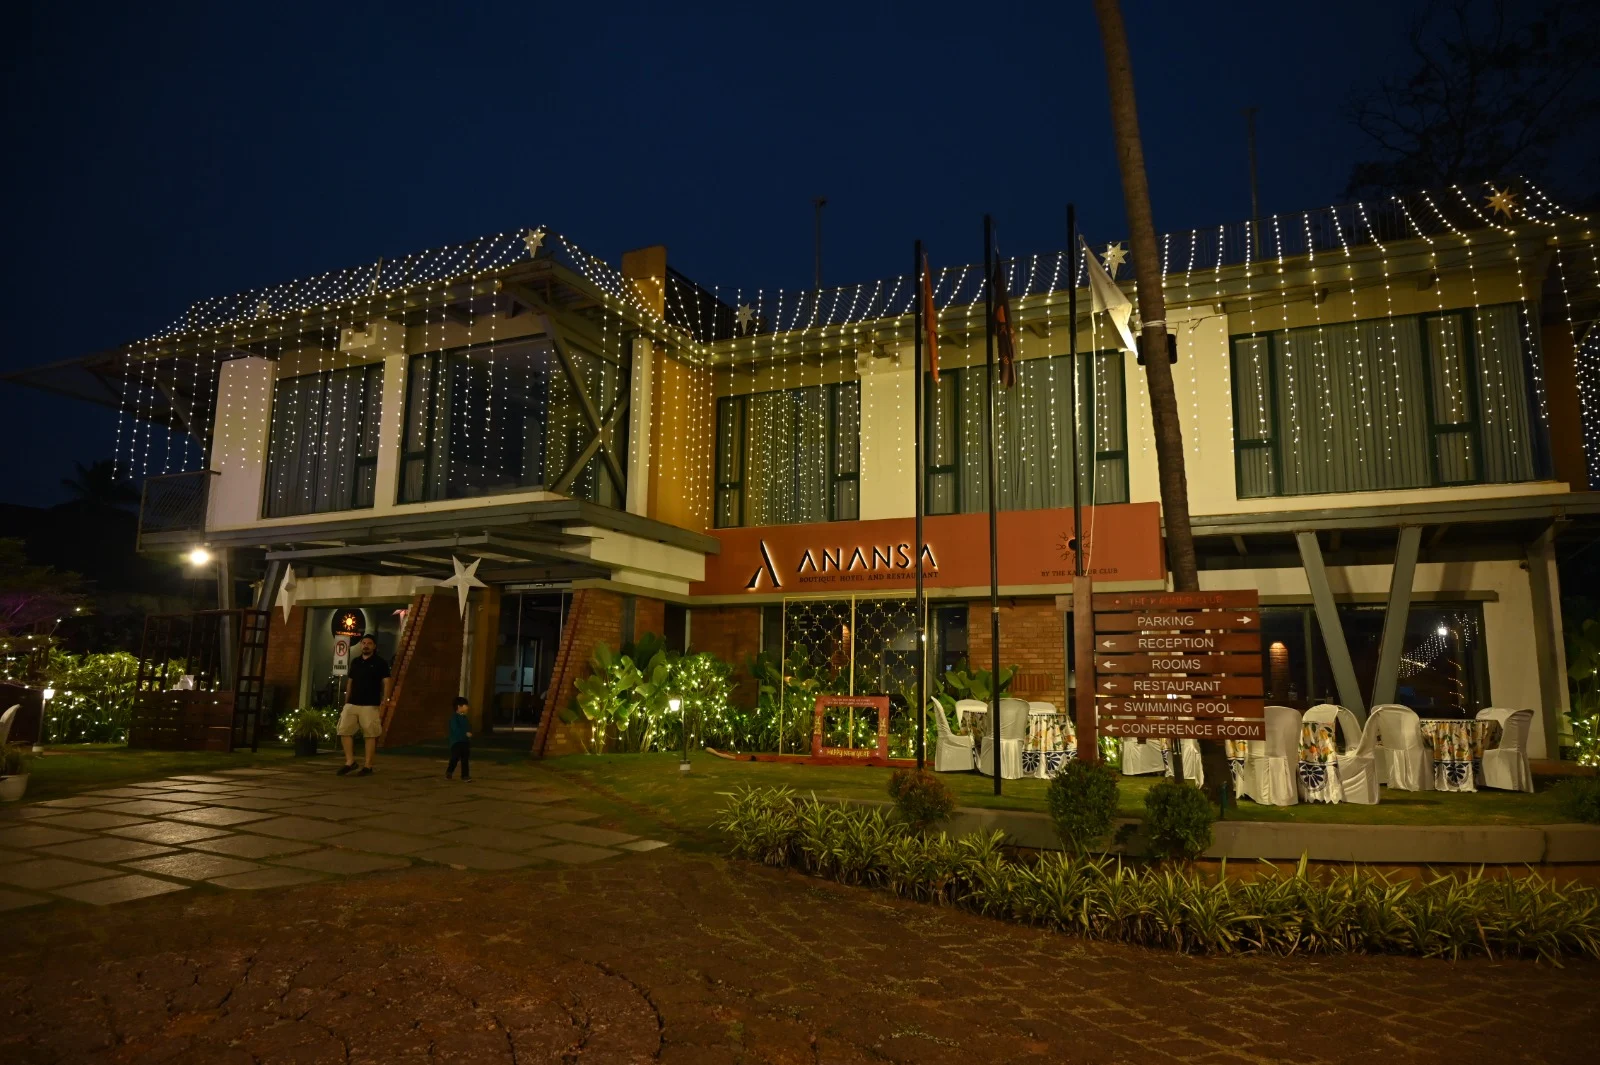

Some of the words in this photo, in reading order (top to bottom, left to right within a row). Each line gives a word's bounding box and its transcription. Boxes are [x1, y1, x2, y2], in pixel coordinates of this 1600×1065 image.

[796, 544, 938, 572] ANANSA
[799, 575, 836, 584] BOUTIQUE
[839, 574, 865, 582] HOTEL
[867, 573, 885, 581] AND
[886, 571, 939, 580] RESTAUANT
[1130, 597, 1146, 605] THE
[1197, 595, 1224, 604] CLUB
[1137, 615, 1194, 627] PARKING
[1138, 637, 1214, 649] RECEPTION
[1151, 659, 1201, 670] ROOMS
[1133, 680, 1222, 692] RESTAURANT
[1123, 702, 1193, 713] SWIMMING
[1196, 702, 1235, 714] POOL
[1121, 723, 1213, 736] CONFERENCE
[1216, 725, 1260, 737] ROOM
